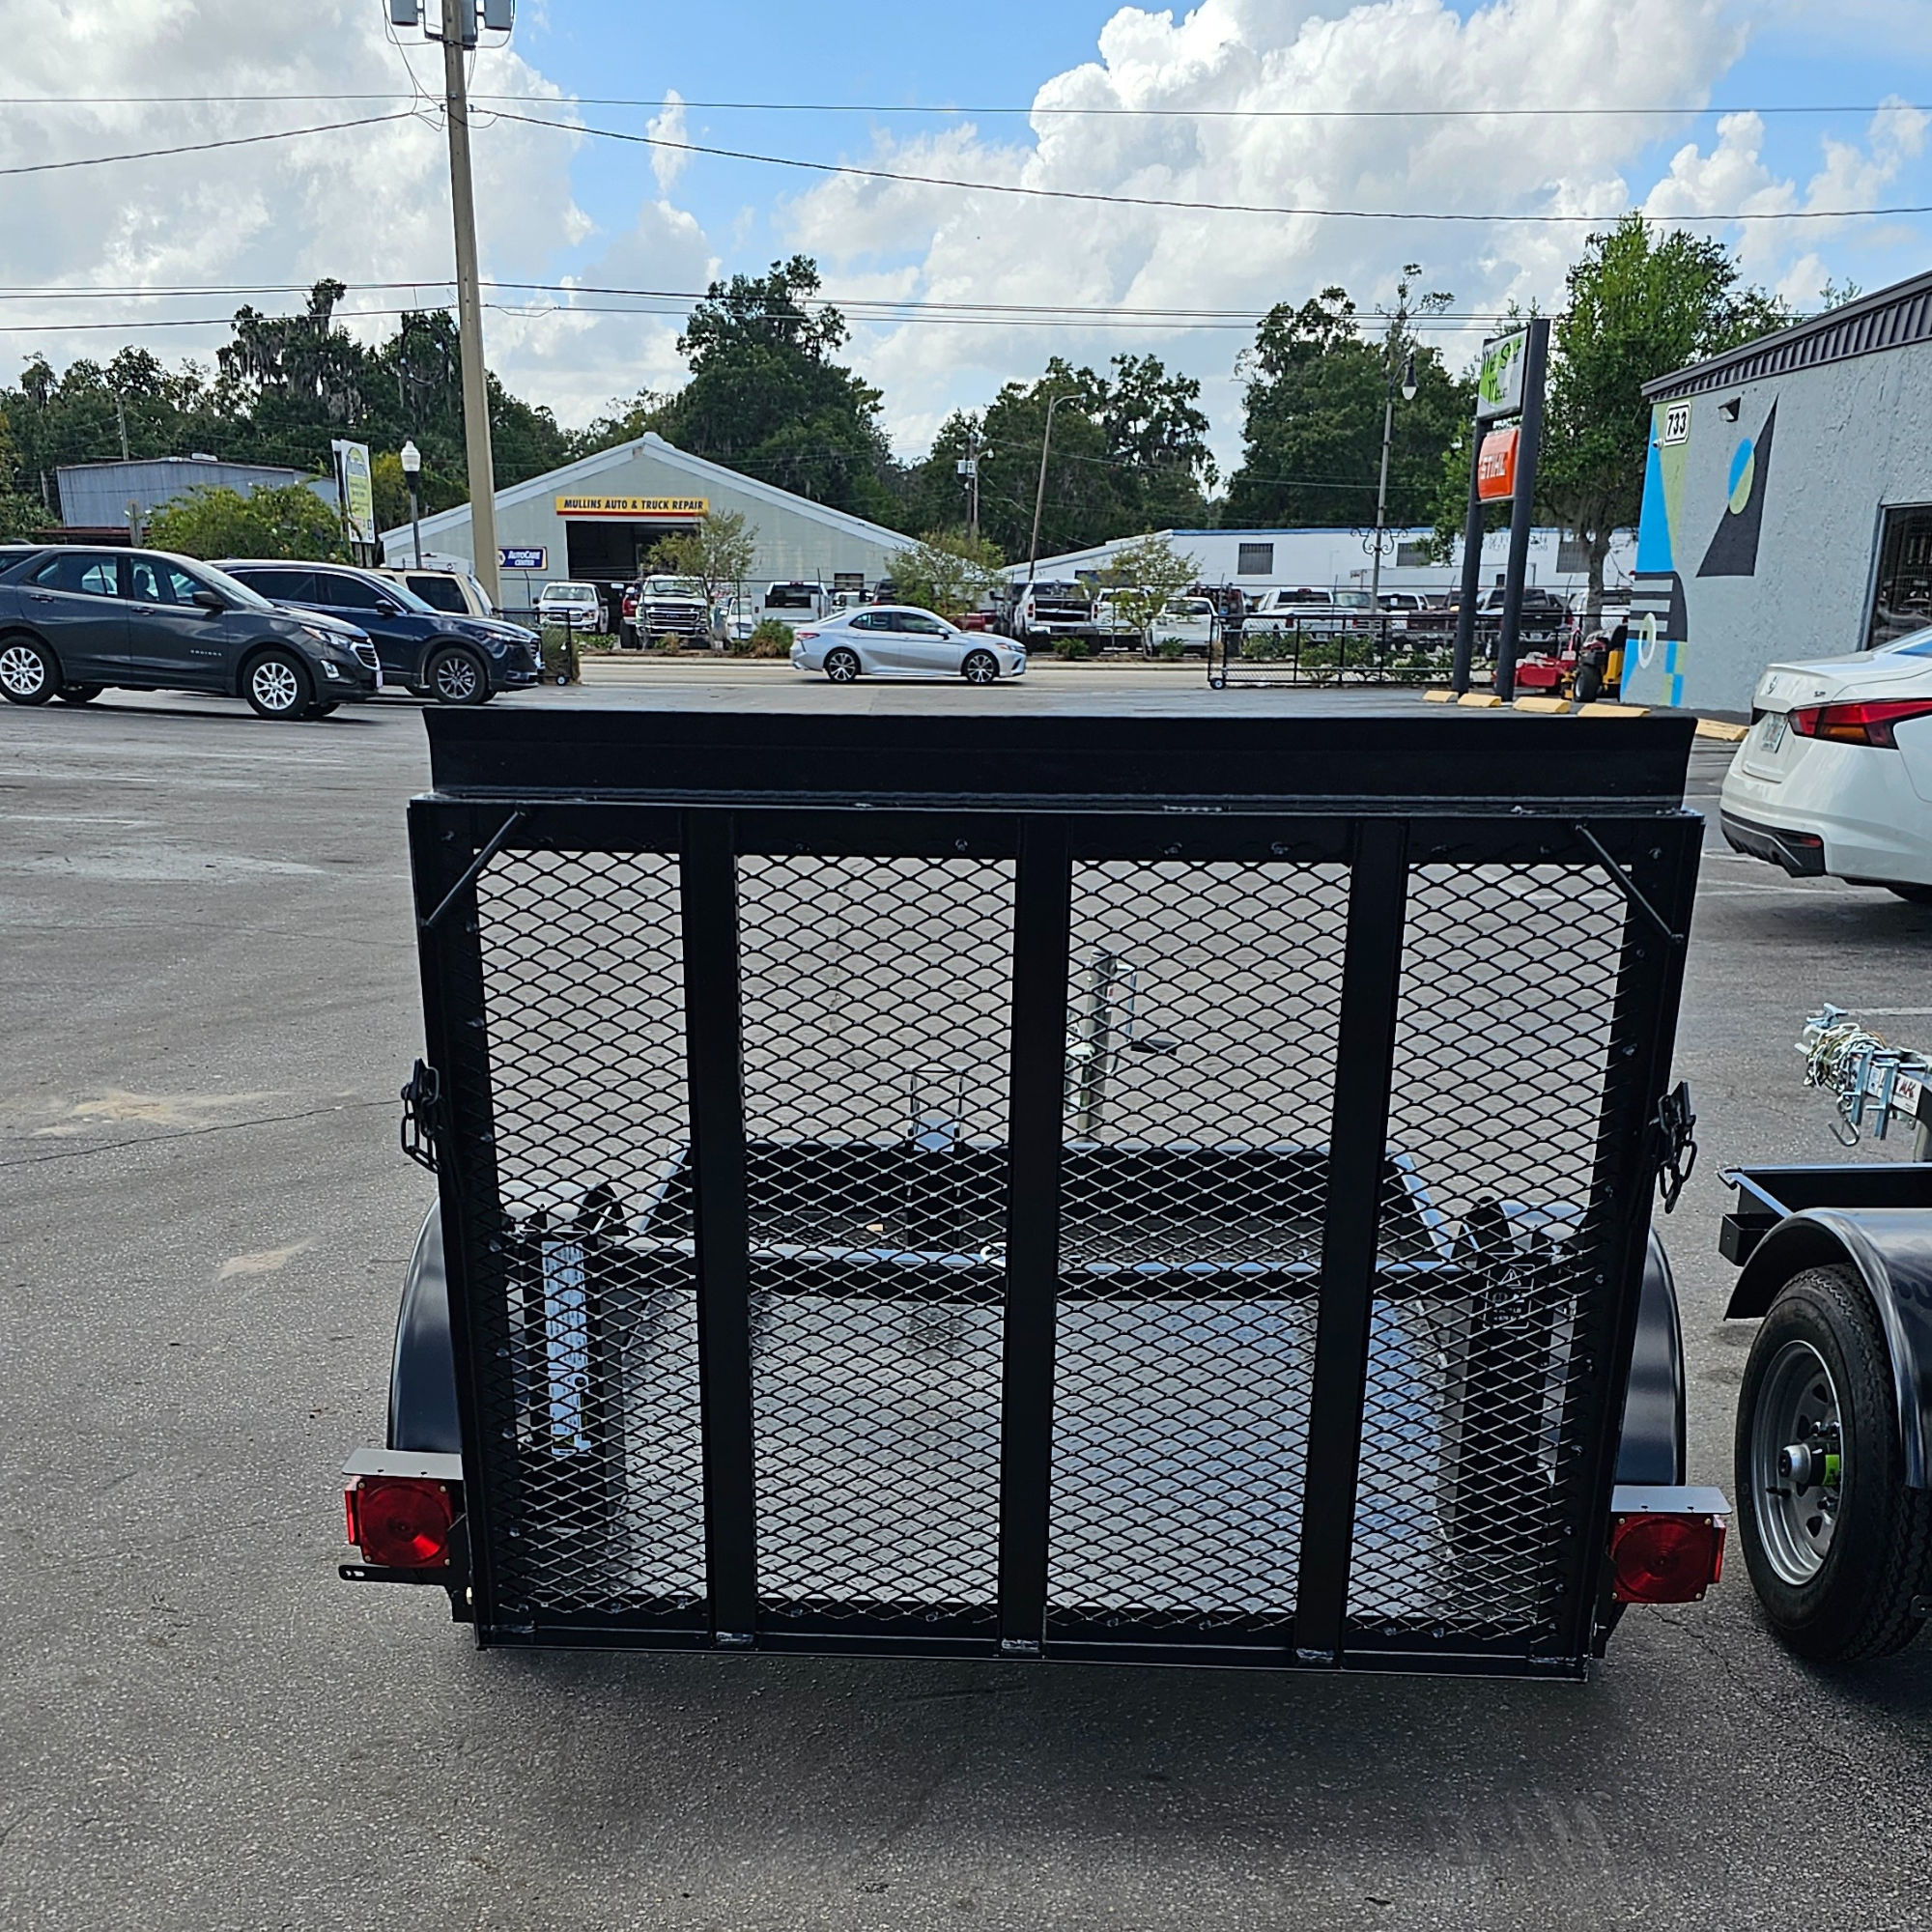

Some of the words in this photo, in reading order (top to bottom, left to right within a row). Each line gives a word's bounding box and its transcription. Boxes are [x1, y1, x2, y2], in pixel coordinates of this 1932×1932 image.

[1667, 412, 1687, 436] 733
[1480, 453, 1506, 480] STIHL
[564, 498, 601, 509] MULLINS
[605, 499, 628, 509] AUTO
[631, 499, 638, 509] &
[641, 499, 668, 509] TRUCK
[672, 500, 703, 510] REPAIR
